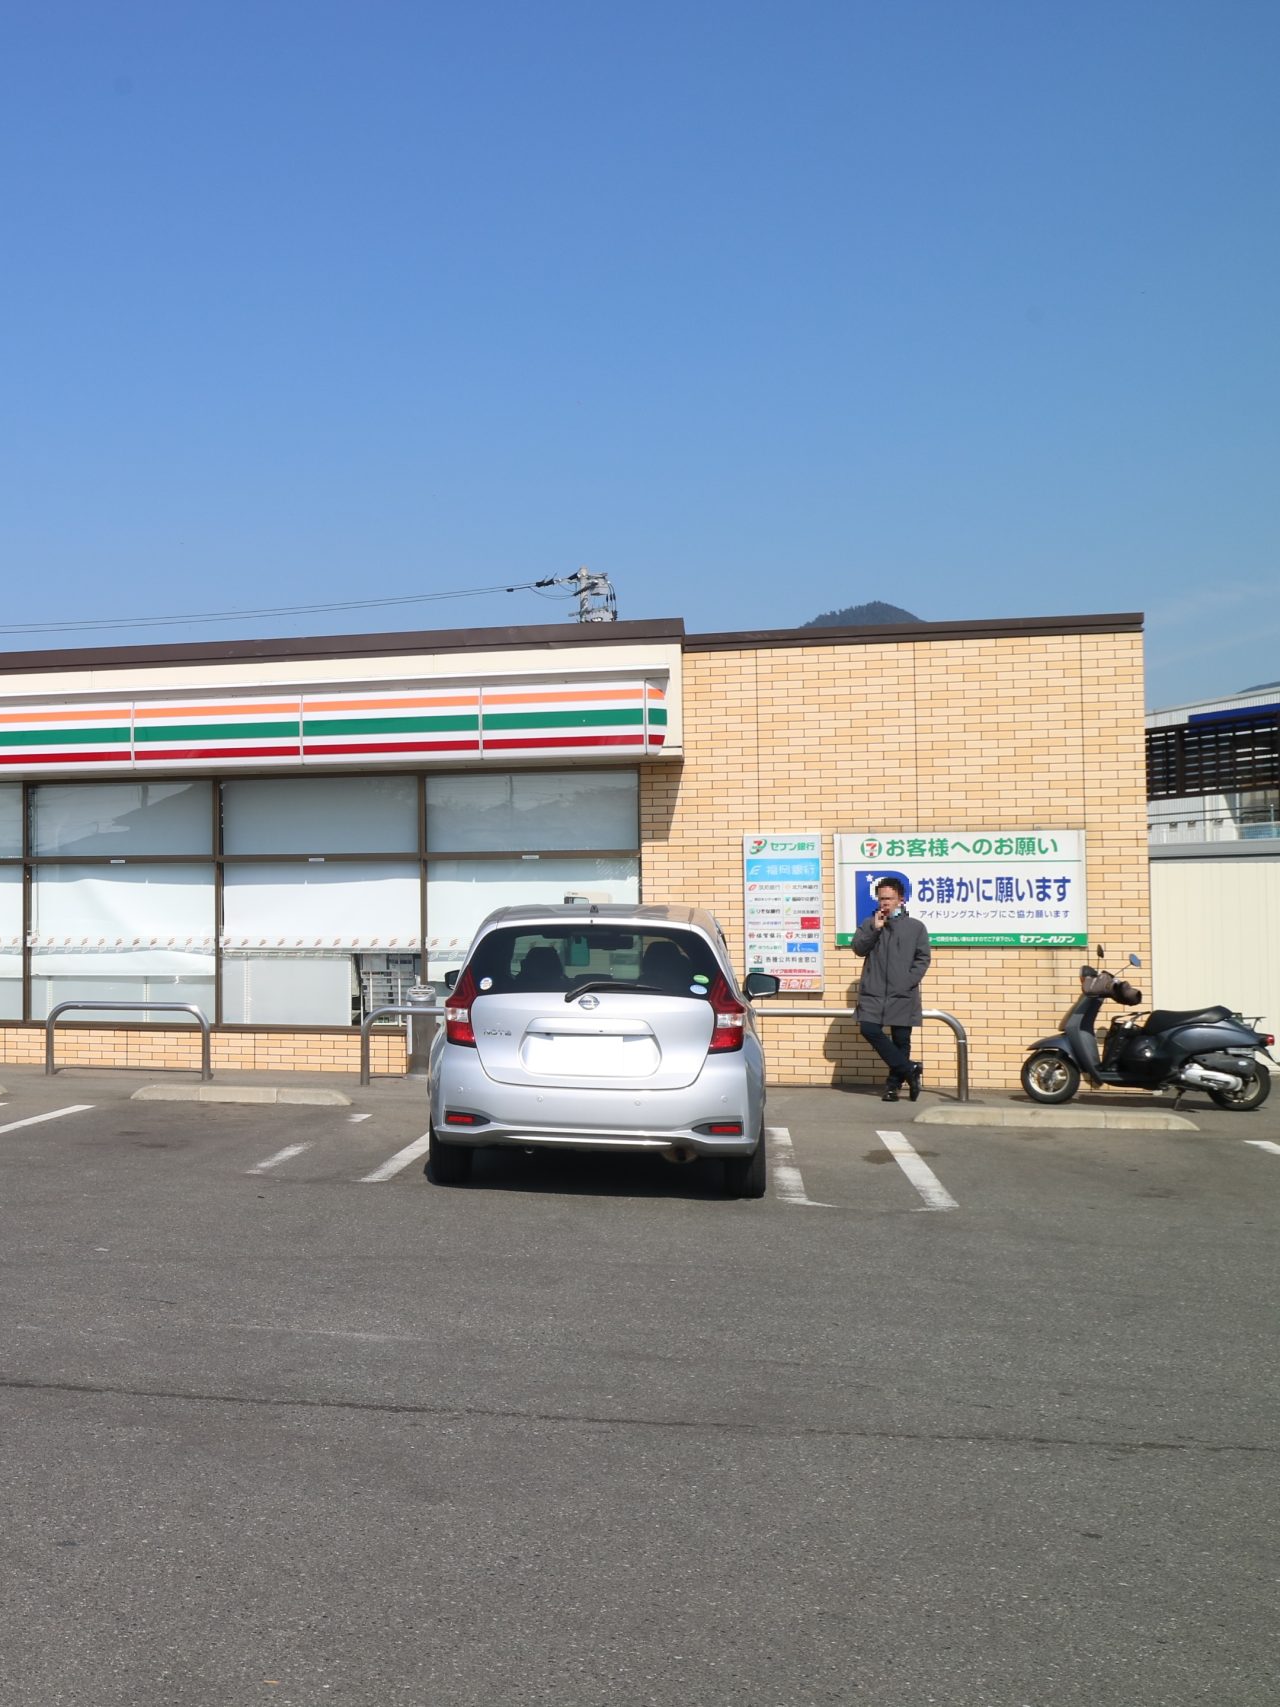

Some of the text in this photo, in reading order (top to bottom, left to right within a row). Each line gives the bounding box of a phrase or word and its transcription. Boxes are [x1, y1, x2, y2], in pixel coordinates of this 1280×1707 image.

[770, 842, 815, 851] セブン銀行
[885, 836, 1058, 858] お客様へのお願い
[766, 863, 816, 876] 福岡銀行
[917, 876, 1072, 904] お静かに願います
[919, 910, 1071, 919] アイドリングストップにご協力願います
